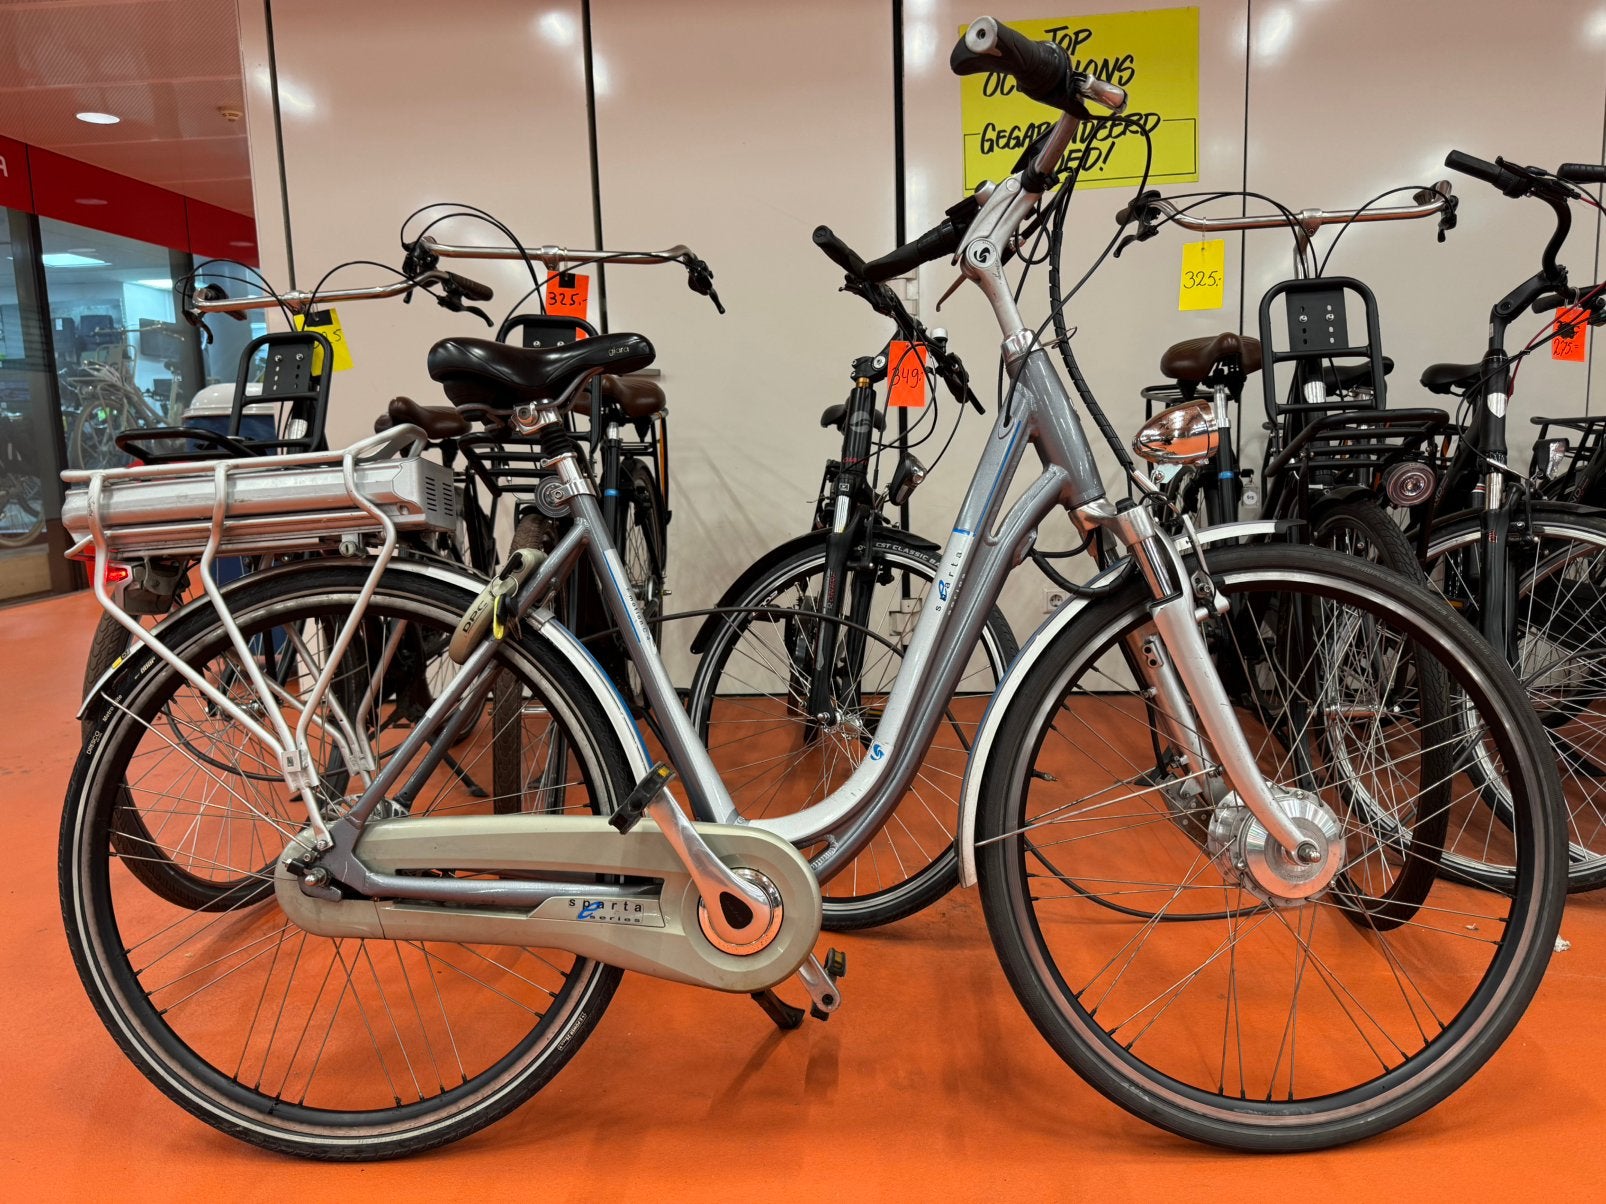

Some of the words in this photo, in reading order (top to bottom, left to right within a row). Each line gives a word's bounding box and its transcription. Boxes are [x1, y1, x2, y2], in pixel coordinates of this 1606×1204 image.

[1044, 25, 1093, 56] TOP
[892, 545, 929, 561] CLASSIC
[462, 600, 488, 633] DPC
[568, 898, 642, 913] sparta
[589, 914, 641, 923] series
